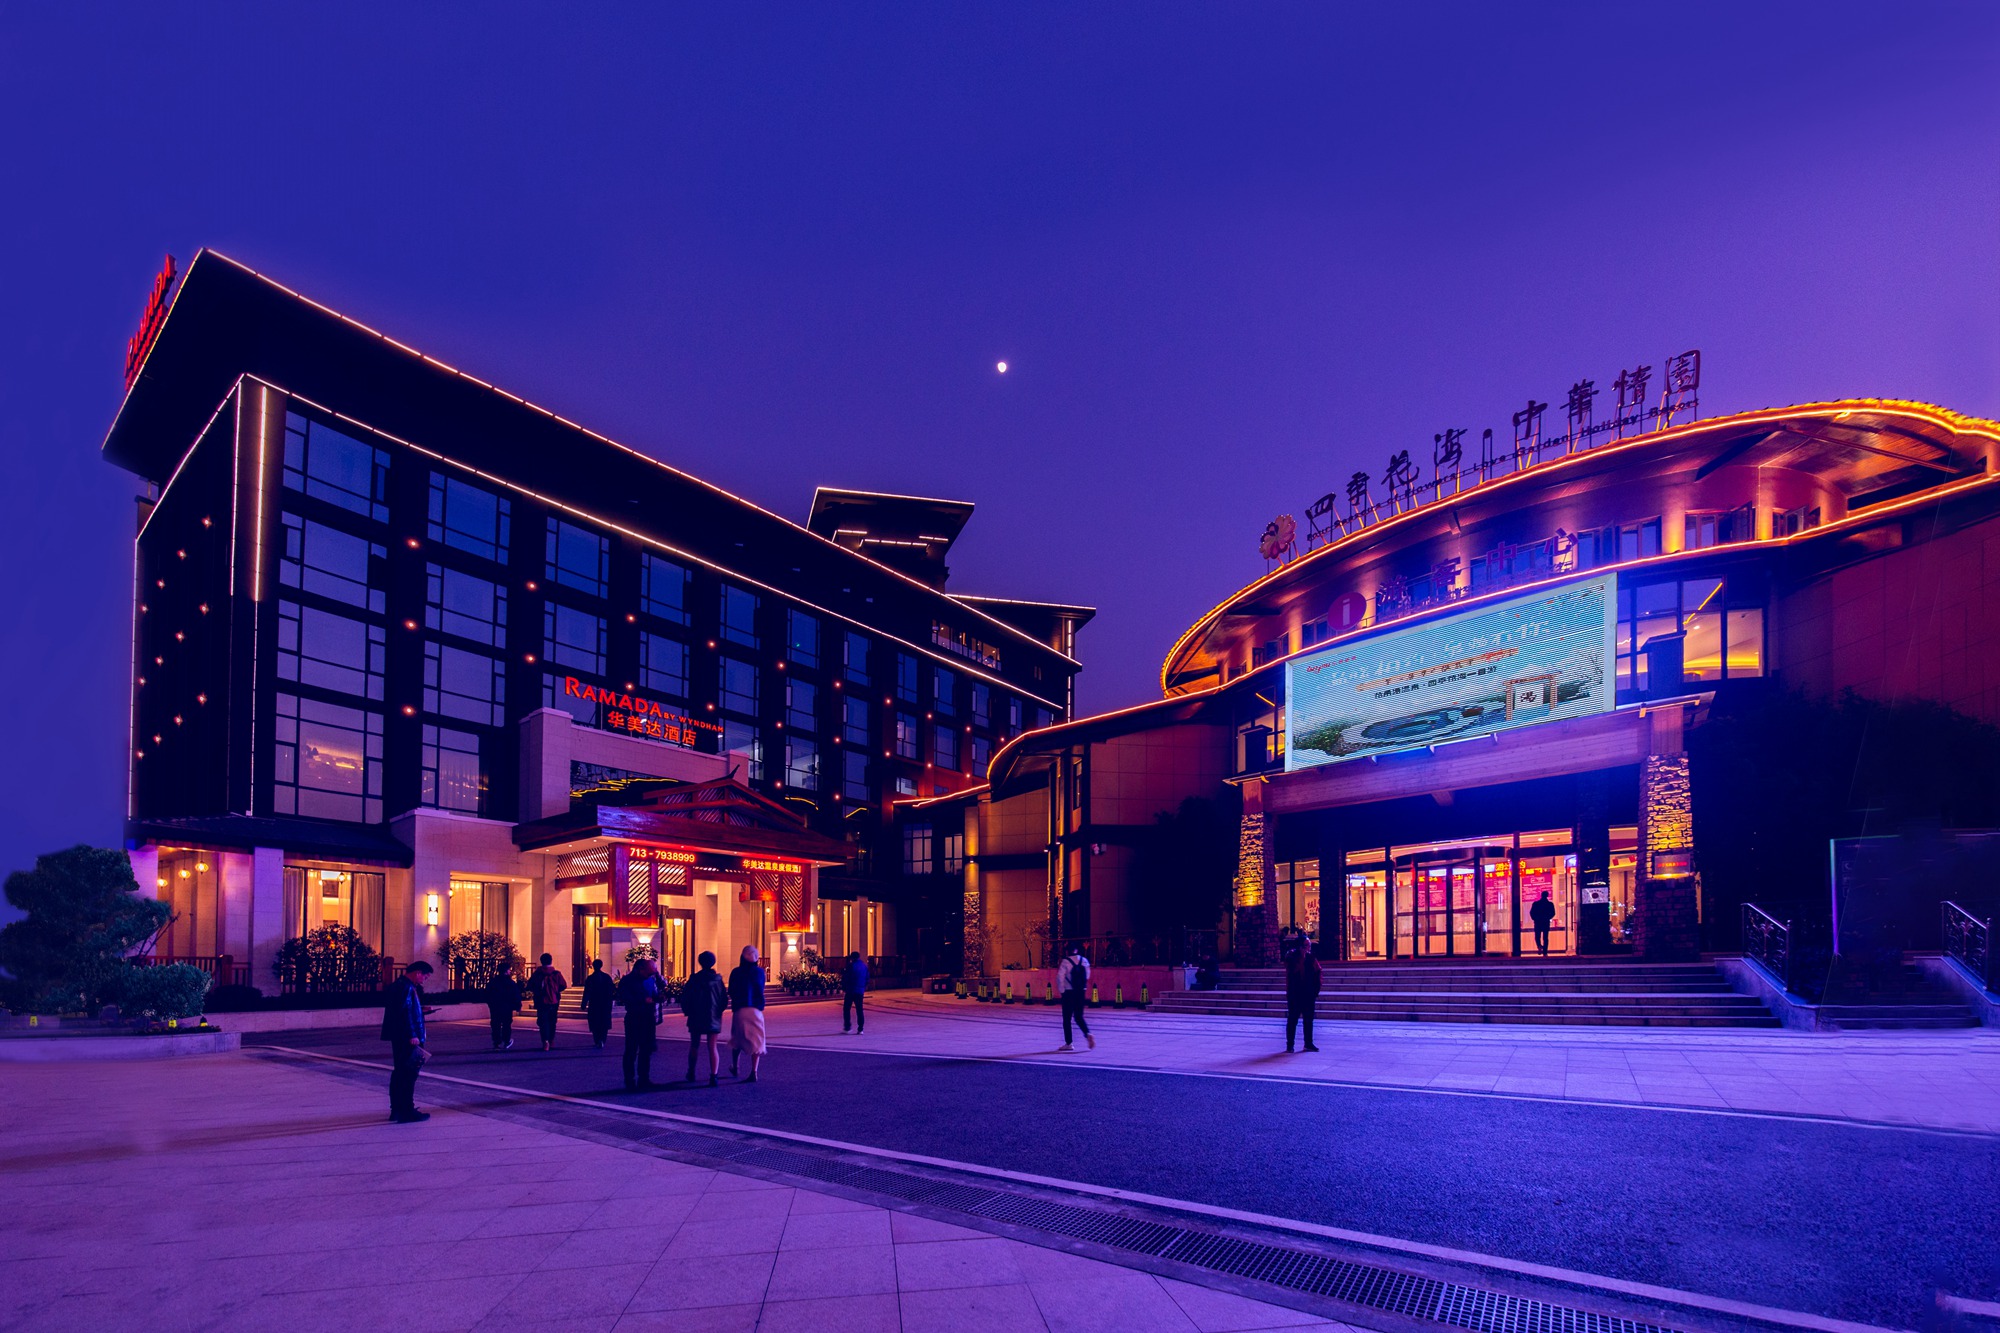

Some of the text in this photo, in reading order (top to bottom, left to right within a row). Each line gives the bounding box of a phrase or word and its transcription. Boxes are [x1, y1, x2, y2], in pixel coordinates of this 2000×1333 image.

[1405, 473, 1456, 496] Flowers
[1474, 455, 1506, 472] Love
[1517, 435, 1569, 457] Garden
[1582, 415, 1638, 436] Holiday
[1650, 399, 1699, 417] Resort
[1378, 528, 1578, 605] 游客中心
[565, 676, 724, 732] RAMADA BY WYNDHAM
[608, 711, 697, 745] 华美达酒店
[742, 859, 801, 873] 华美达温泉度假酒
